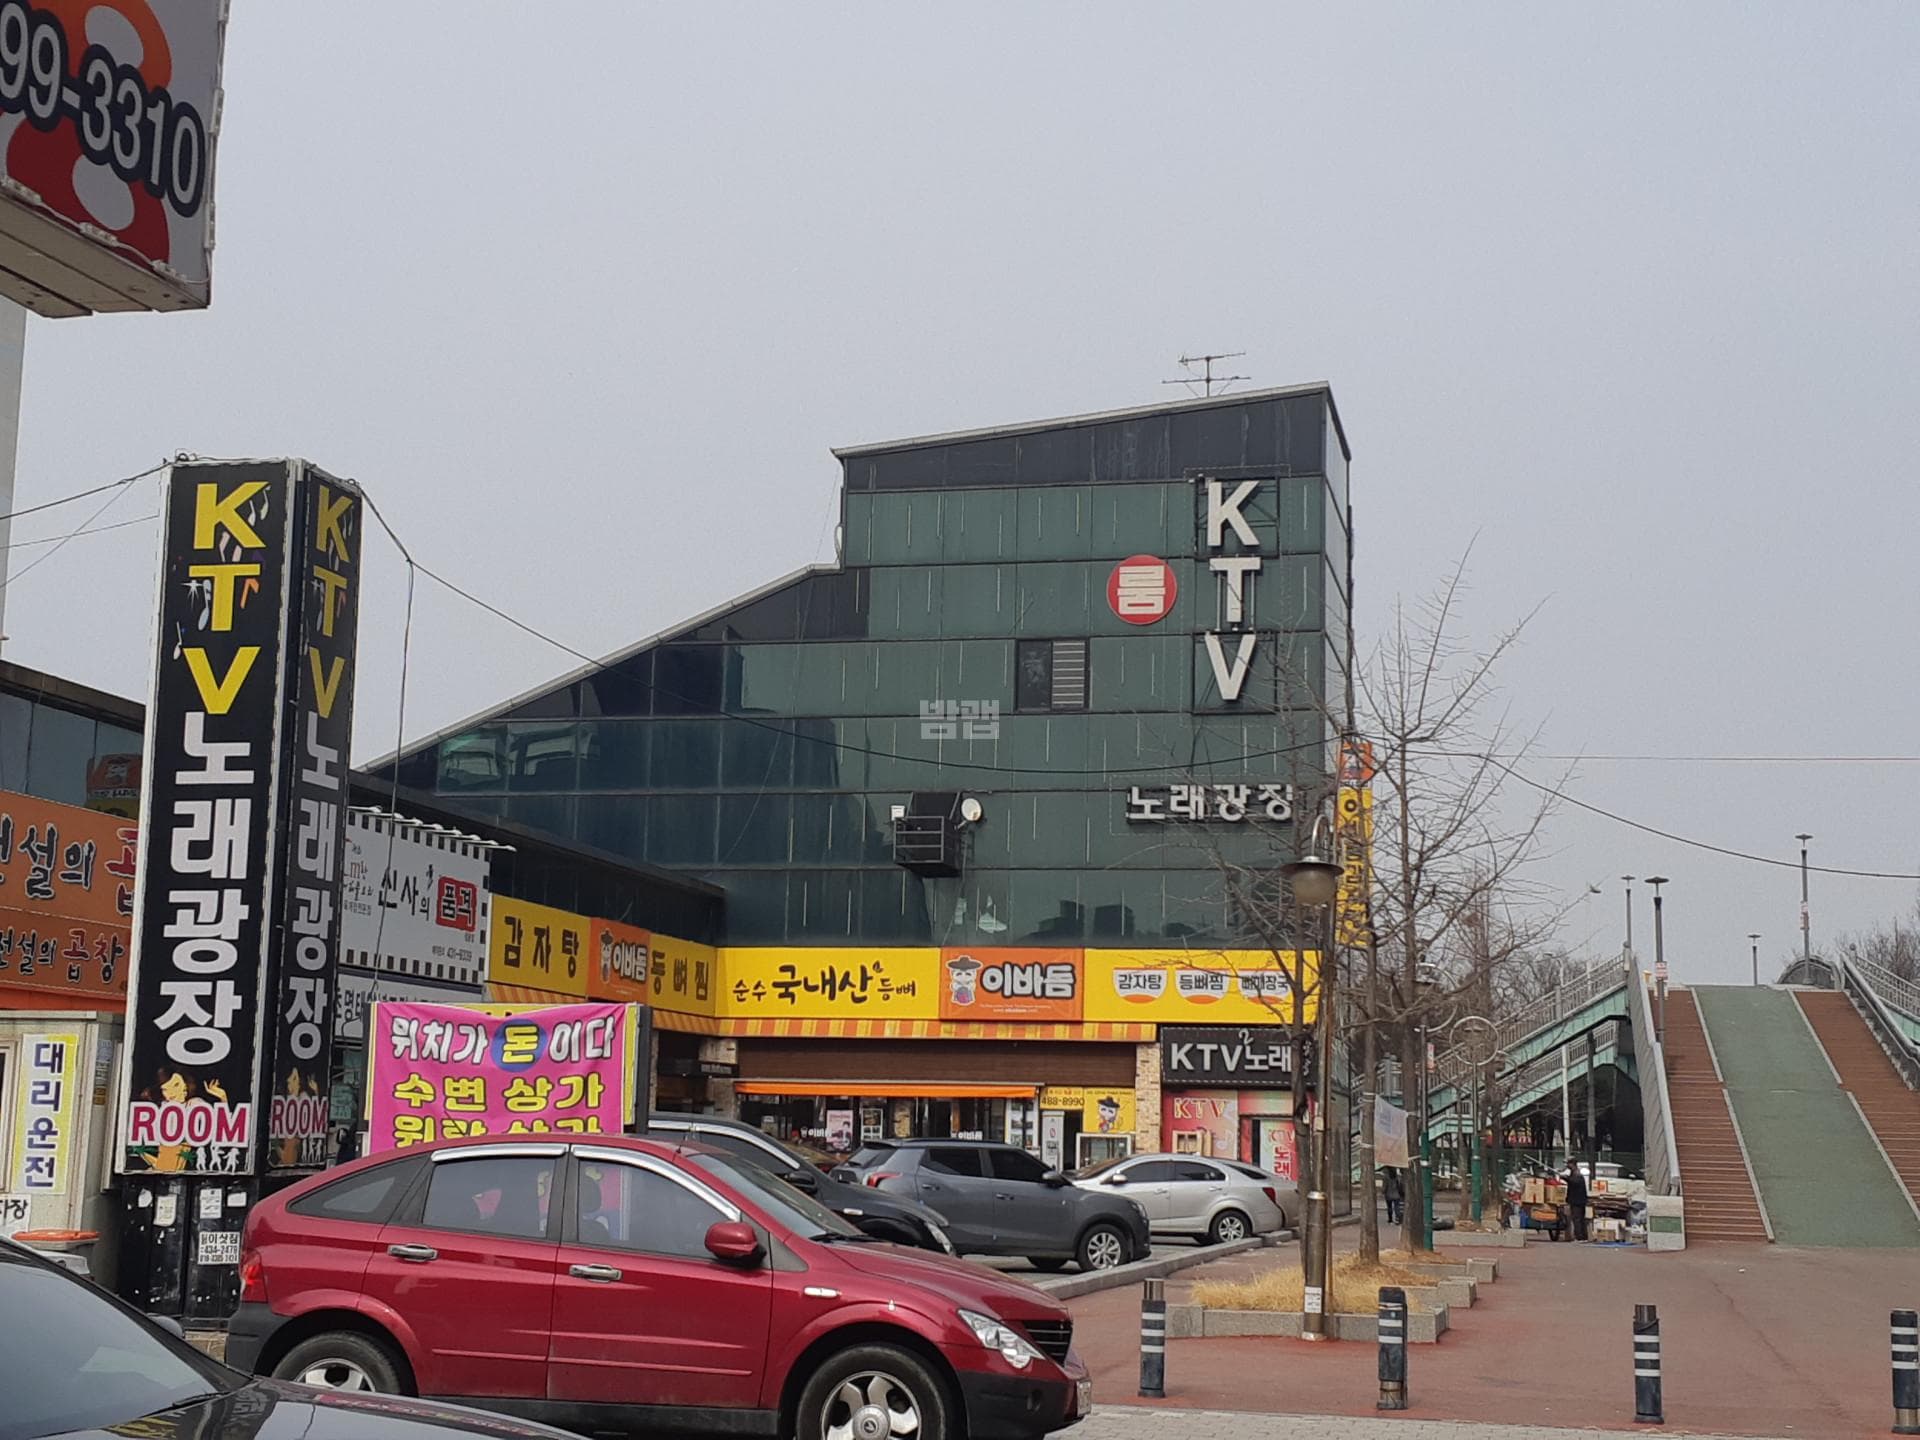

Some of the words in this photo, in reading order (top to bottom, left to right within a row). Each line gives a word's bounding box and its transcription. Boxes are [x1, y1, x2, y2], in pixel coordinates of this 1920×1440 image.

[1117, 565, 1165, 615] 룸
[1204, 480, 1261, 700] KTV
[504, 915, 580, 978] 감자탕
[651, 950, 709, 1001] 등뼈찜
[733, 979, 767, 1002] 순수
[772, 965, 873, 1005] 국내산
[877, 977, 917, 1002] 등뼈
[1118, 973, 1162, 990] 감자탕
[1179, 974, 1224, 991] 등뼈찜
[393, 1072, 489, 1112] 수변
[503, 1072, 605, 1115] 상가
[1174, 1098, 1227, 1119] KTV
[24, 1043, 65, 1188] 대리운전
[130, 1106, 247, 1142] ROOM
[272, 1097, 328, 1136] ROOM
